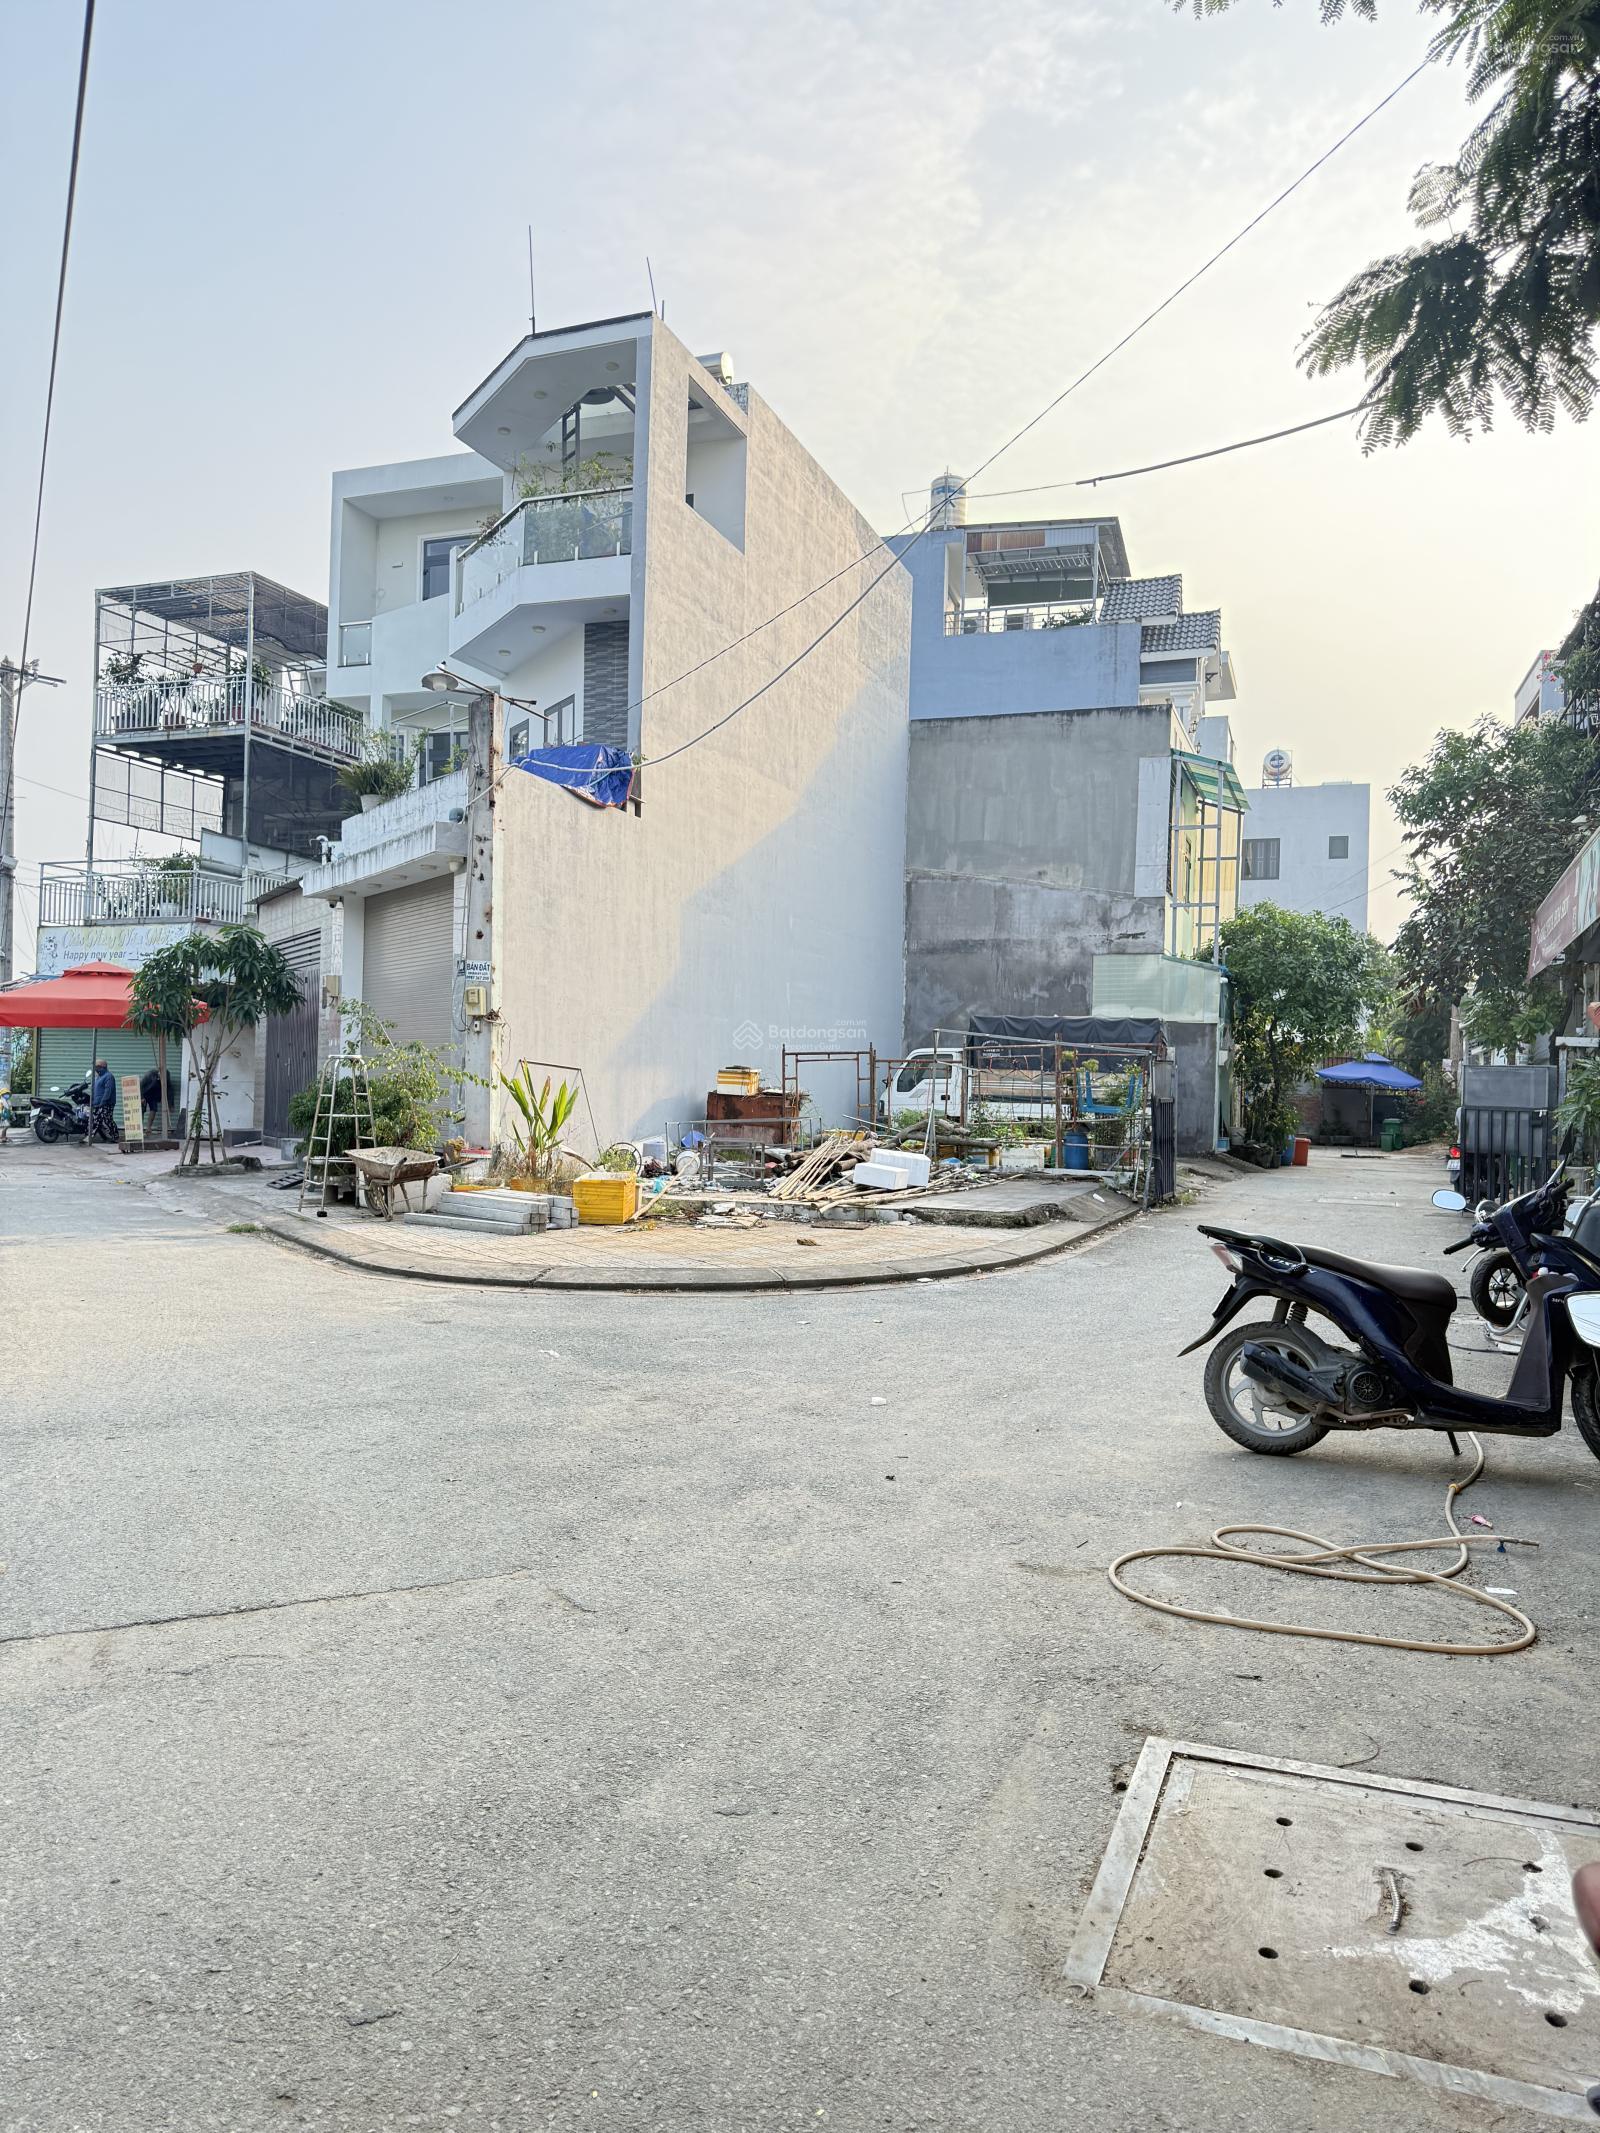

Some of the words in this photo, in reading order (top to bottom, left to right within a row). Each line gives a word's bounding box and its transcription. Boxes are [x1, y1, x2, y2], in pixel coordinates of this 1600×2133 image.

[63, 950, 89, 961] Happy
[90, 951, 107, 960] new
[109, 950, 126, 961] year
